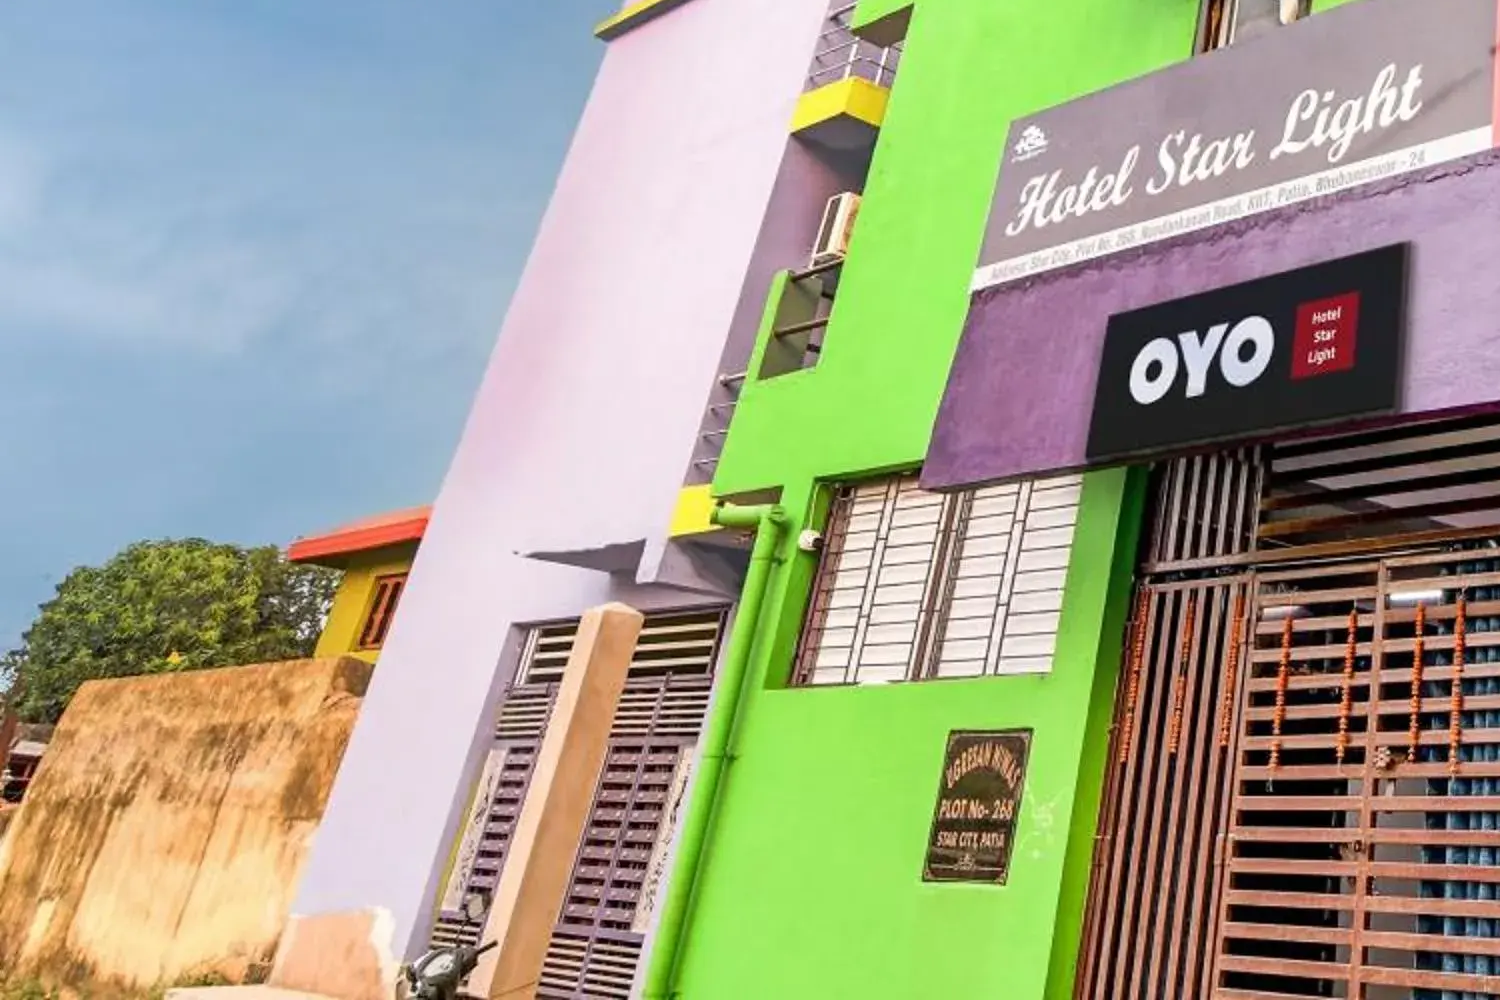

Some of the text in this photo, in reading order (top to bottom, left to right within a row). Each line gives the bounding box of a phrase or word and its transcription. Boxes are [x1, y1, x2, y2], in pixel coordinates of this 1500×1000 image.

[1006, 63, 1423, 238] Hotel Star Light
[1312, 306, 1342, 325] Hotel
[1313, 327, 1337, 344] Star
[1128, 315, 1275, 405] OYO
[1308, 346, 1336, 365] Light
[939, 799, 968, 820] PLOT
[991, 799, 1014, 821] 268
[937, 831, 958, 848] STAR
